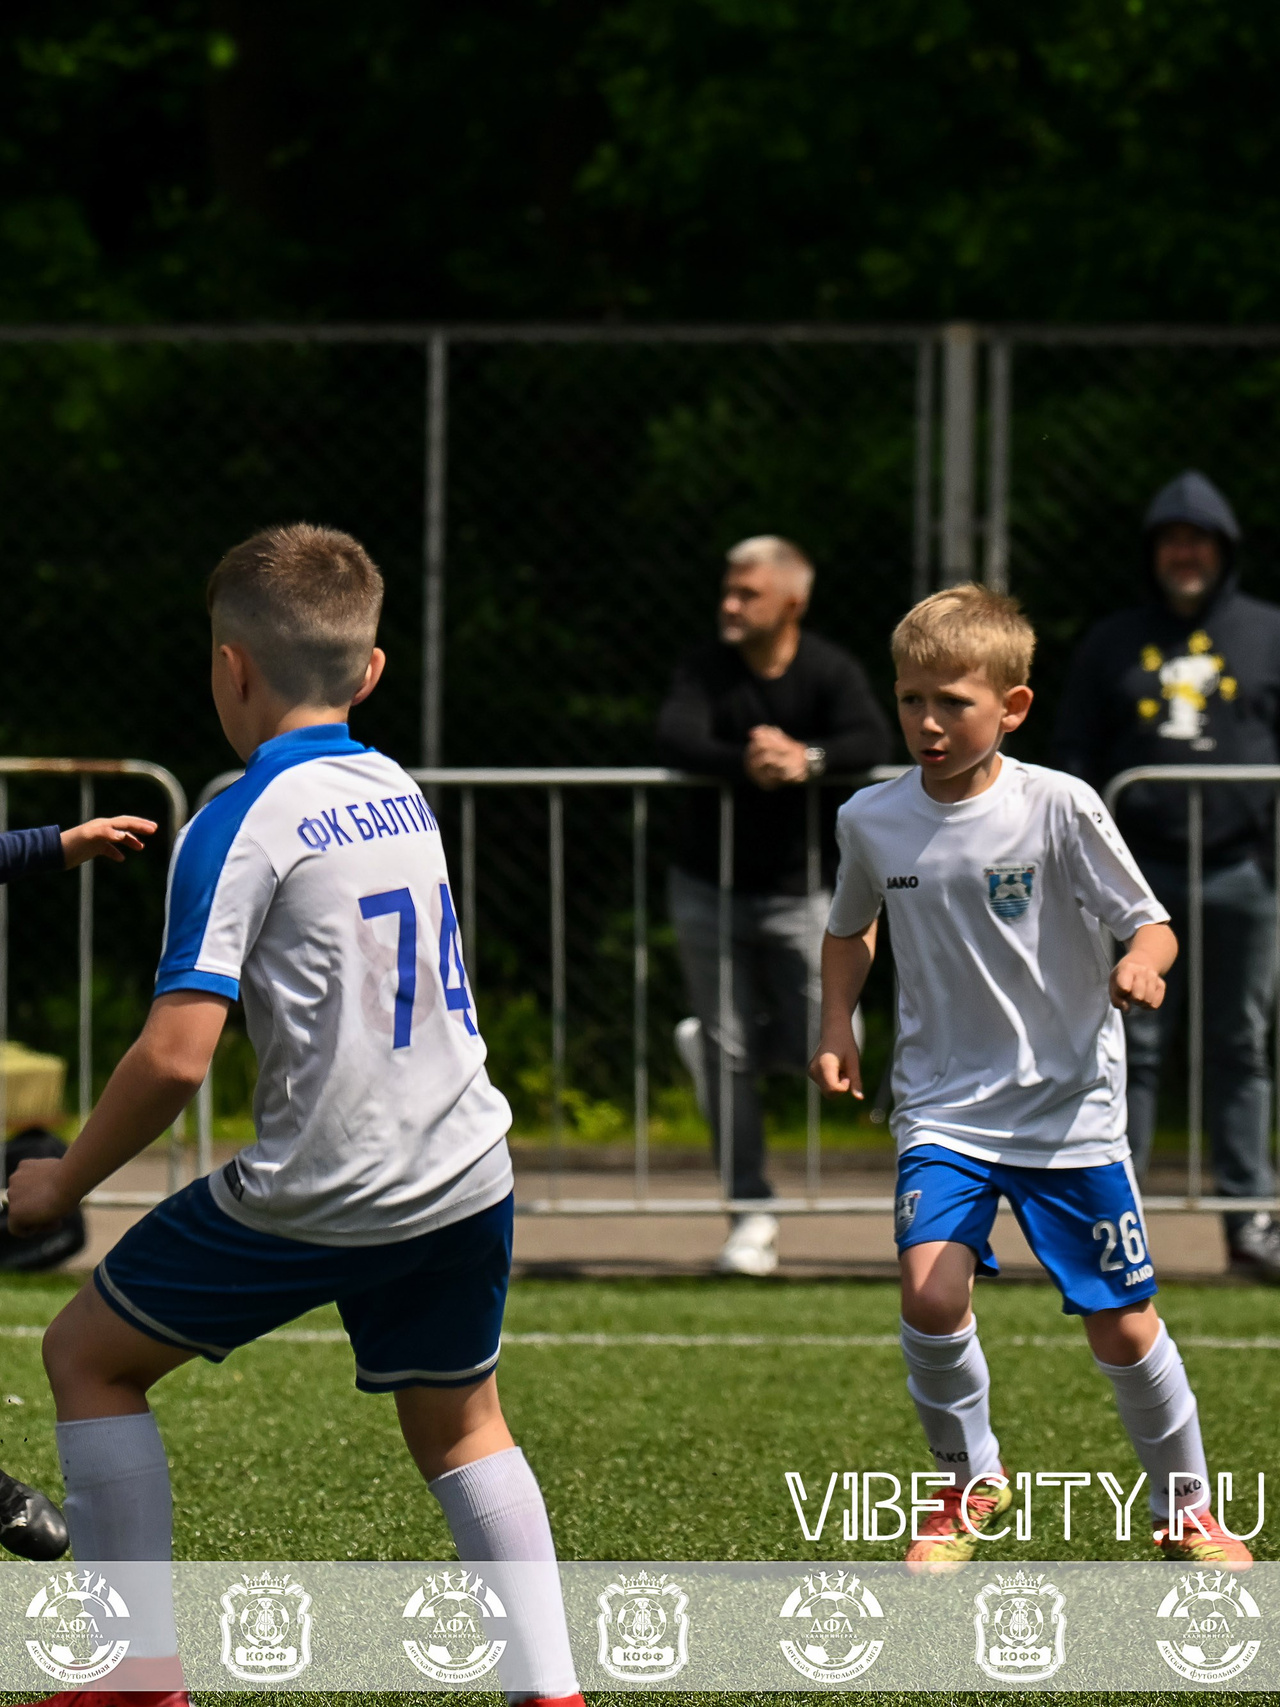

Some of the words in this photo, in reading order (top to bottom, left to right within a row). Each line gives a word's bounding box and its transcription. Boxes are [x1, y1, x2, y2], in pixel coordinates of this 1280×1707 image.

[297, 806, 353, 851] ФК
[886, 876, 919, 889] JAKO
[358, 883, 478, 1050] 74
[1093, 1211, 1145, 1272] 26
[1125, 1264, 1154, 1287] JAKO
